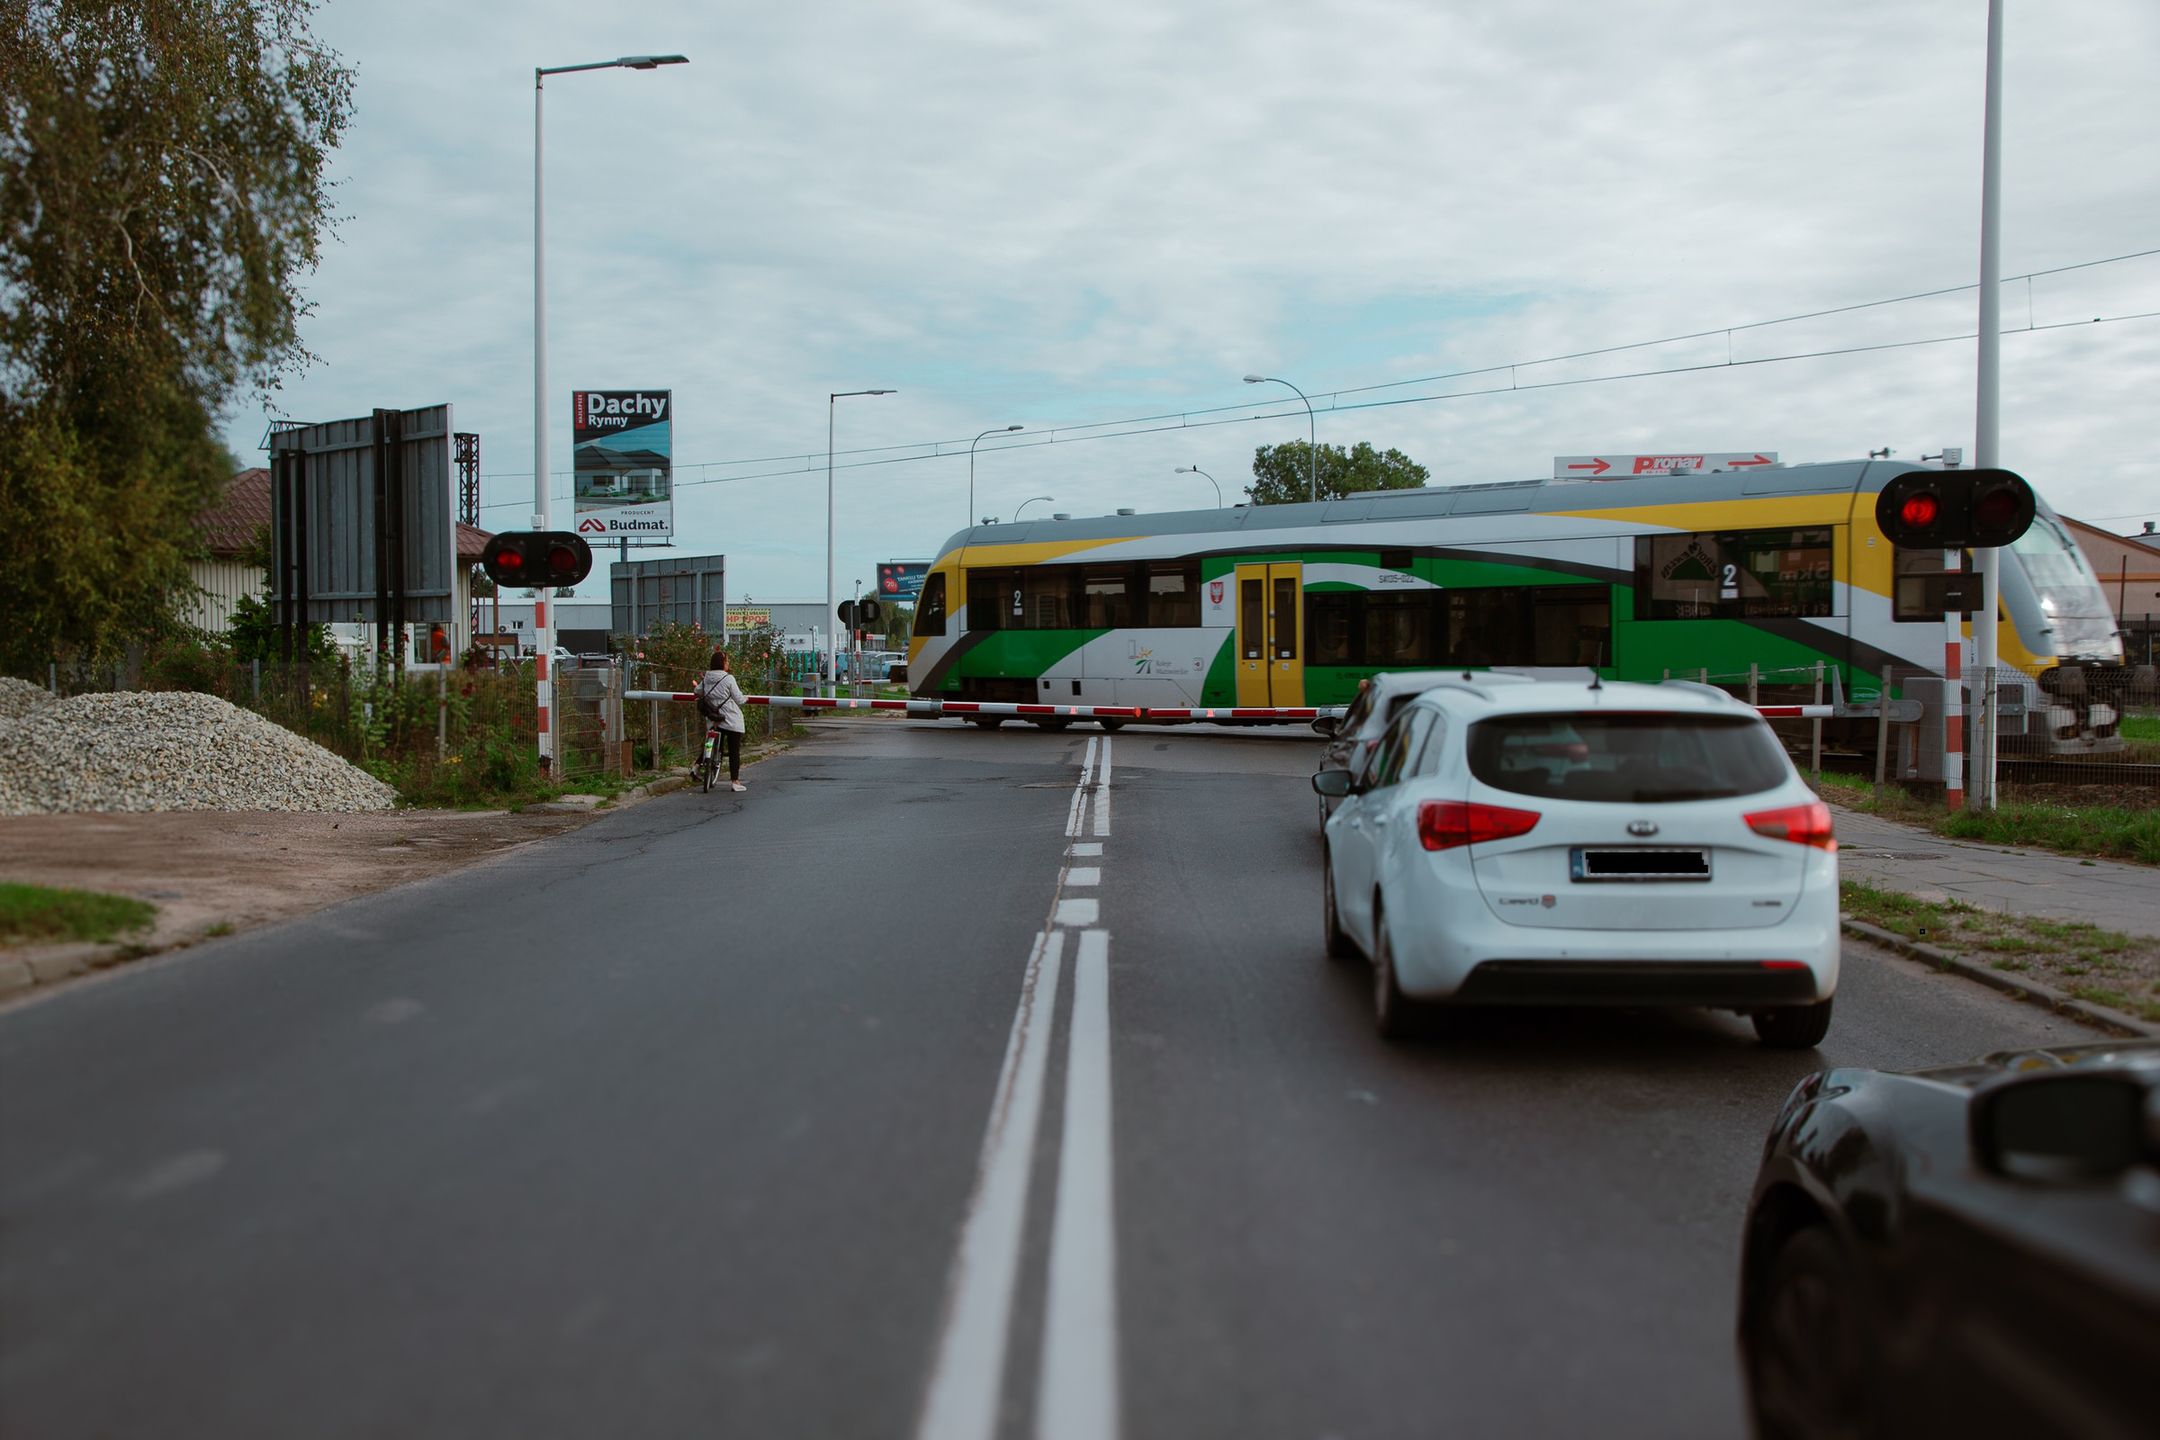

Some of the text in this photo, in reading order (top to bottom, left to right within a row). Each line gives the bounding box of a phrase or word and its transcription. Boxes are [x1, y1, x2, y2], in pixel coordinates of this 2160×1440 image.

[588, 393, 667, 419] Dachy
[588, 414, 628, 428] Rynny
[1633, 456, 1704, 474] Pronar
[609, 519, 669, 530] Budmat.
[1723, 564, 1737, 586] 2
[1014, 590, 1022, 606] 2
